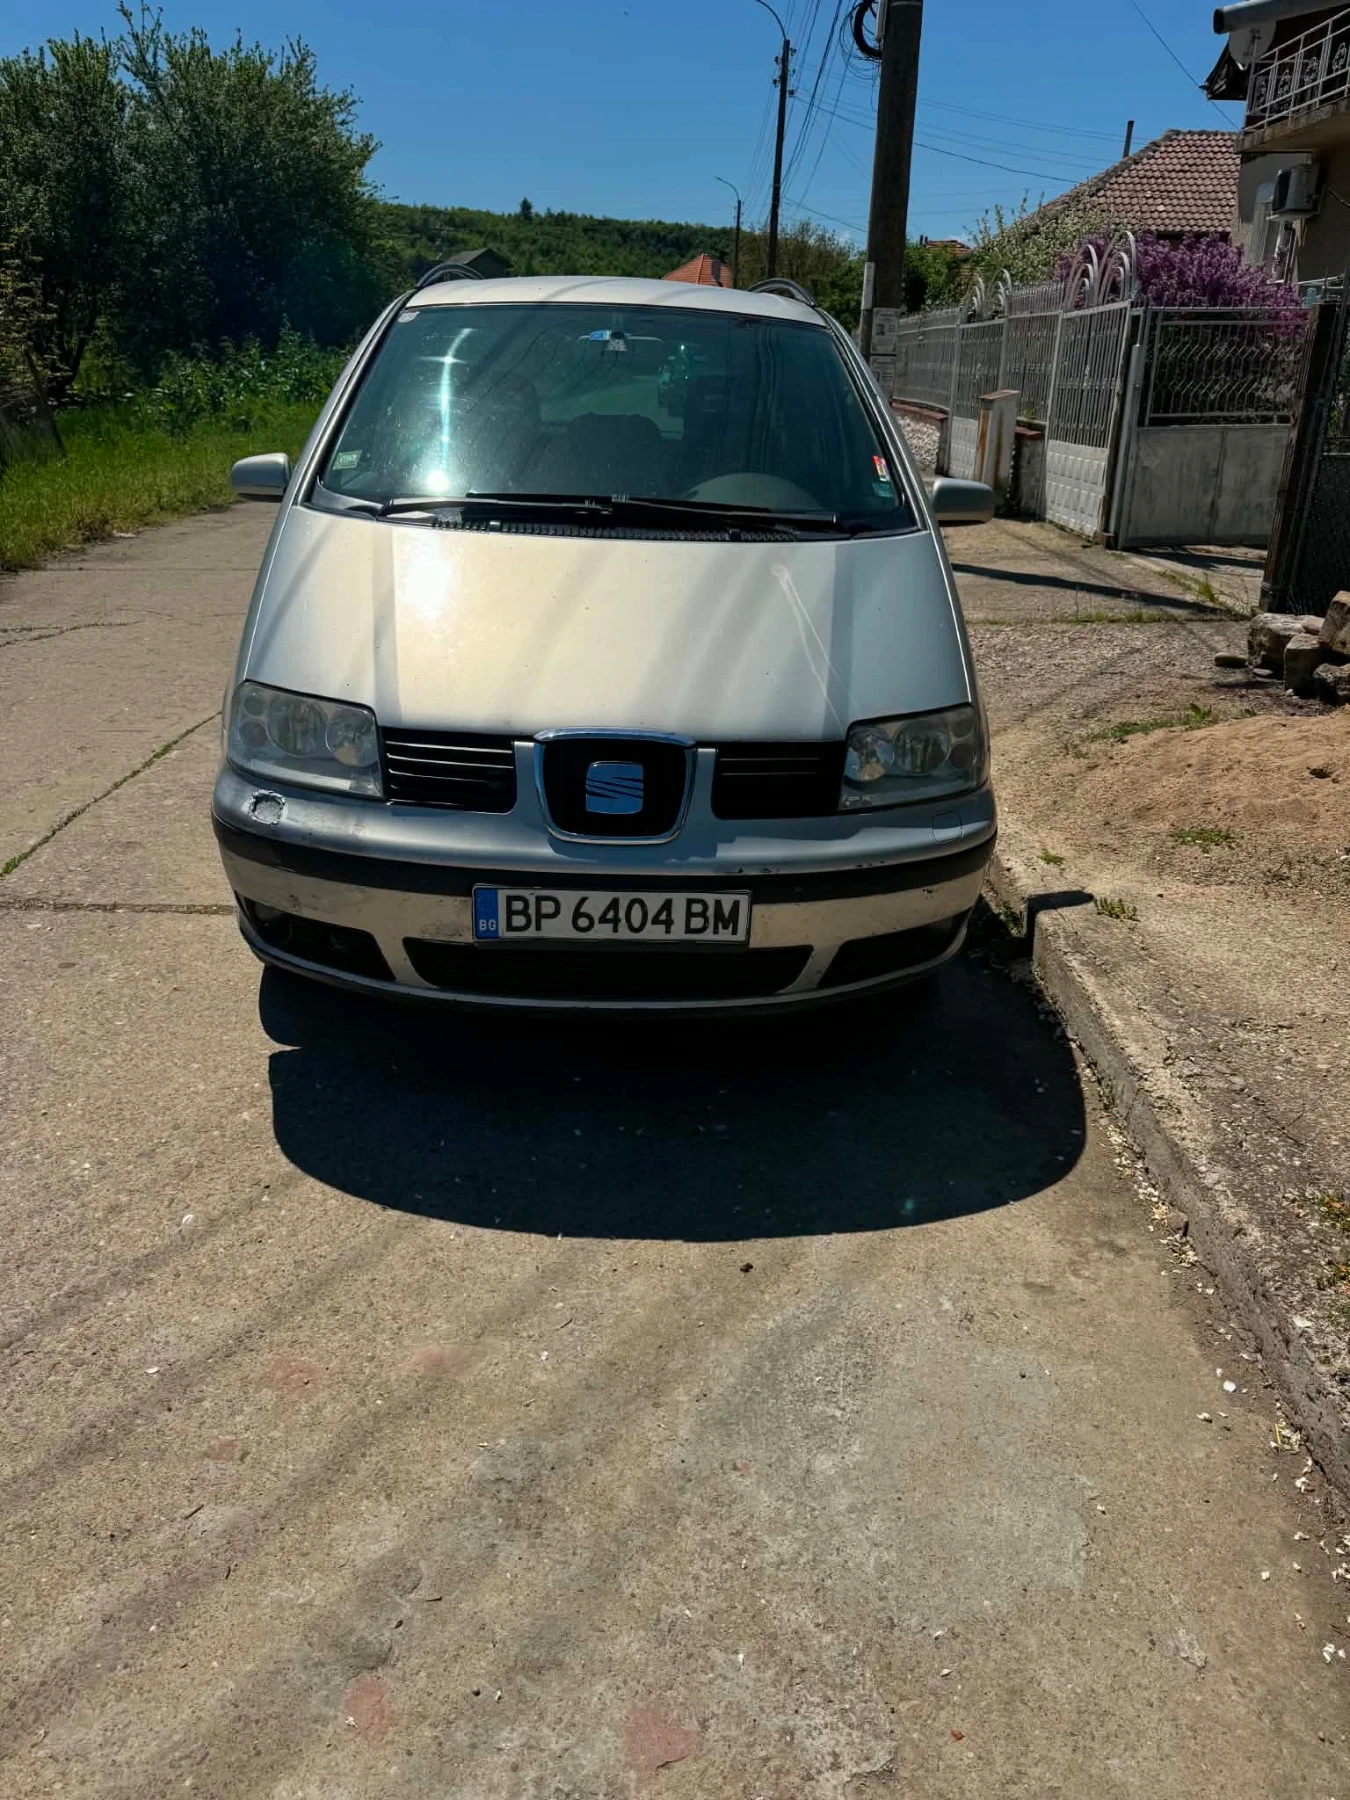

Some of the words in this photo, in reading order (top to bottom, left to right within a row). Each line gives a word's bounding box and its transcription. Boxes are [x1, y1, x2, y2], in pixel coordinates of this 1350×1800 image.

[479, 919, 497, 931] BG
[505, 895, 561, 933] BP
[571, 896, 674, 935] 6404
[684, 898, 741, 936] BM
